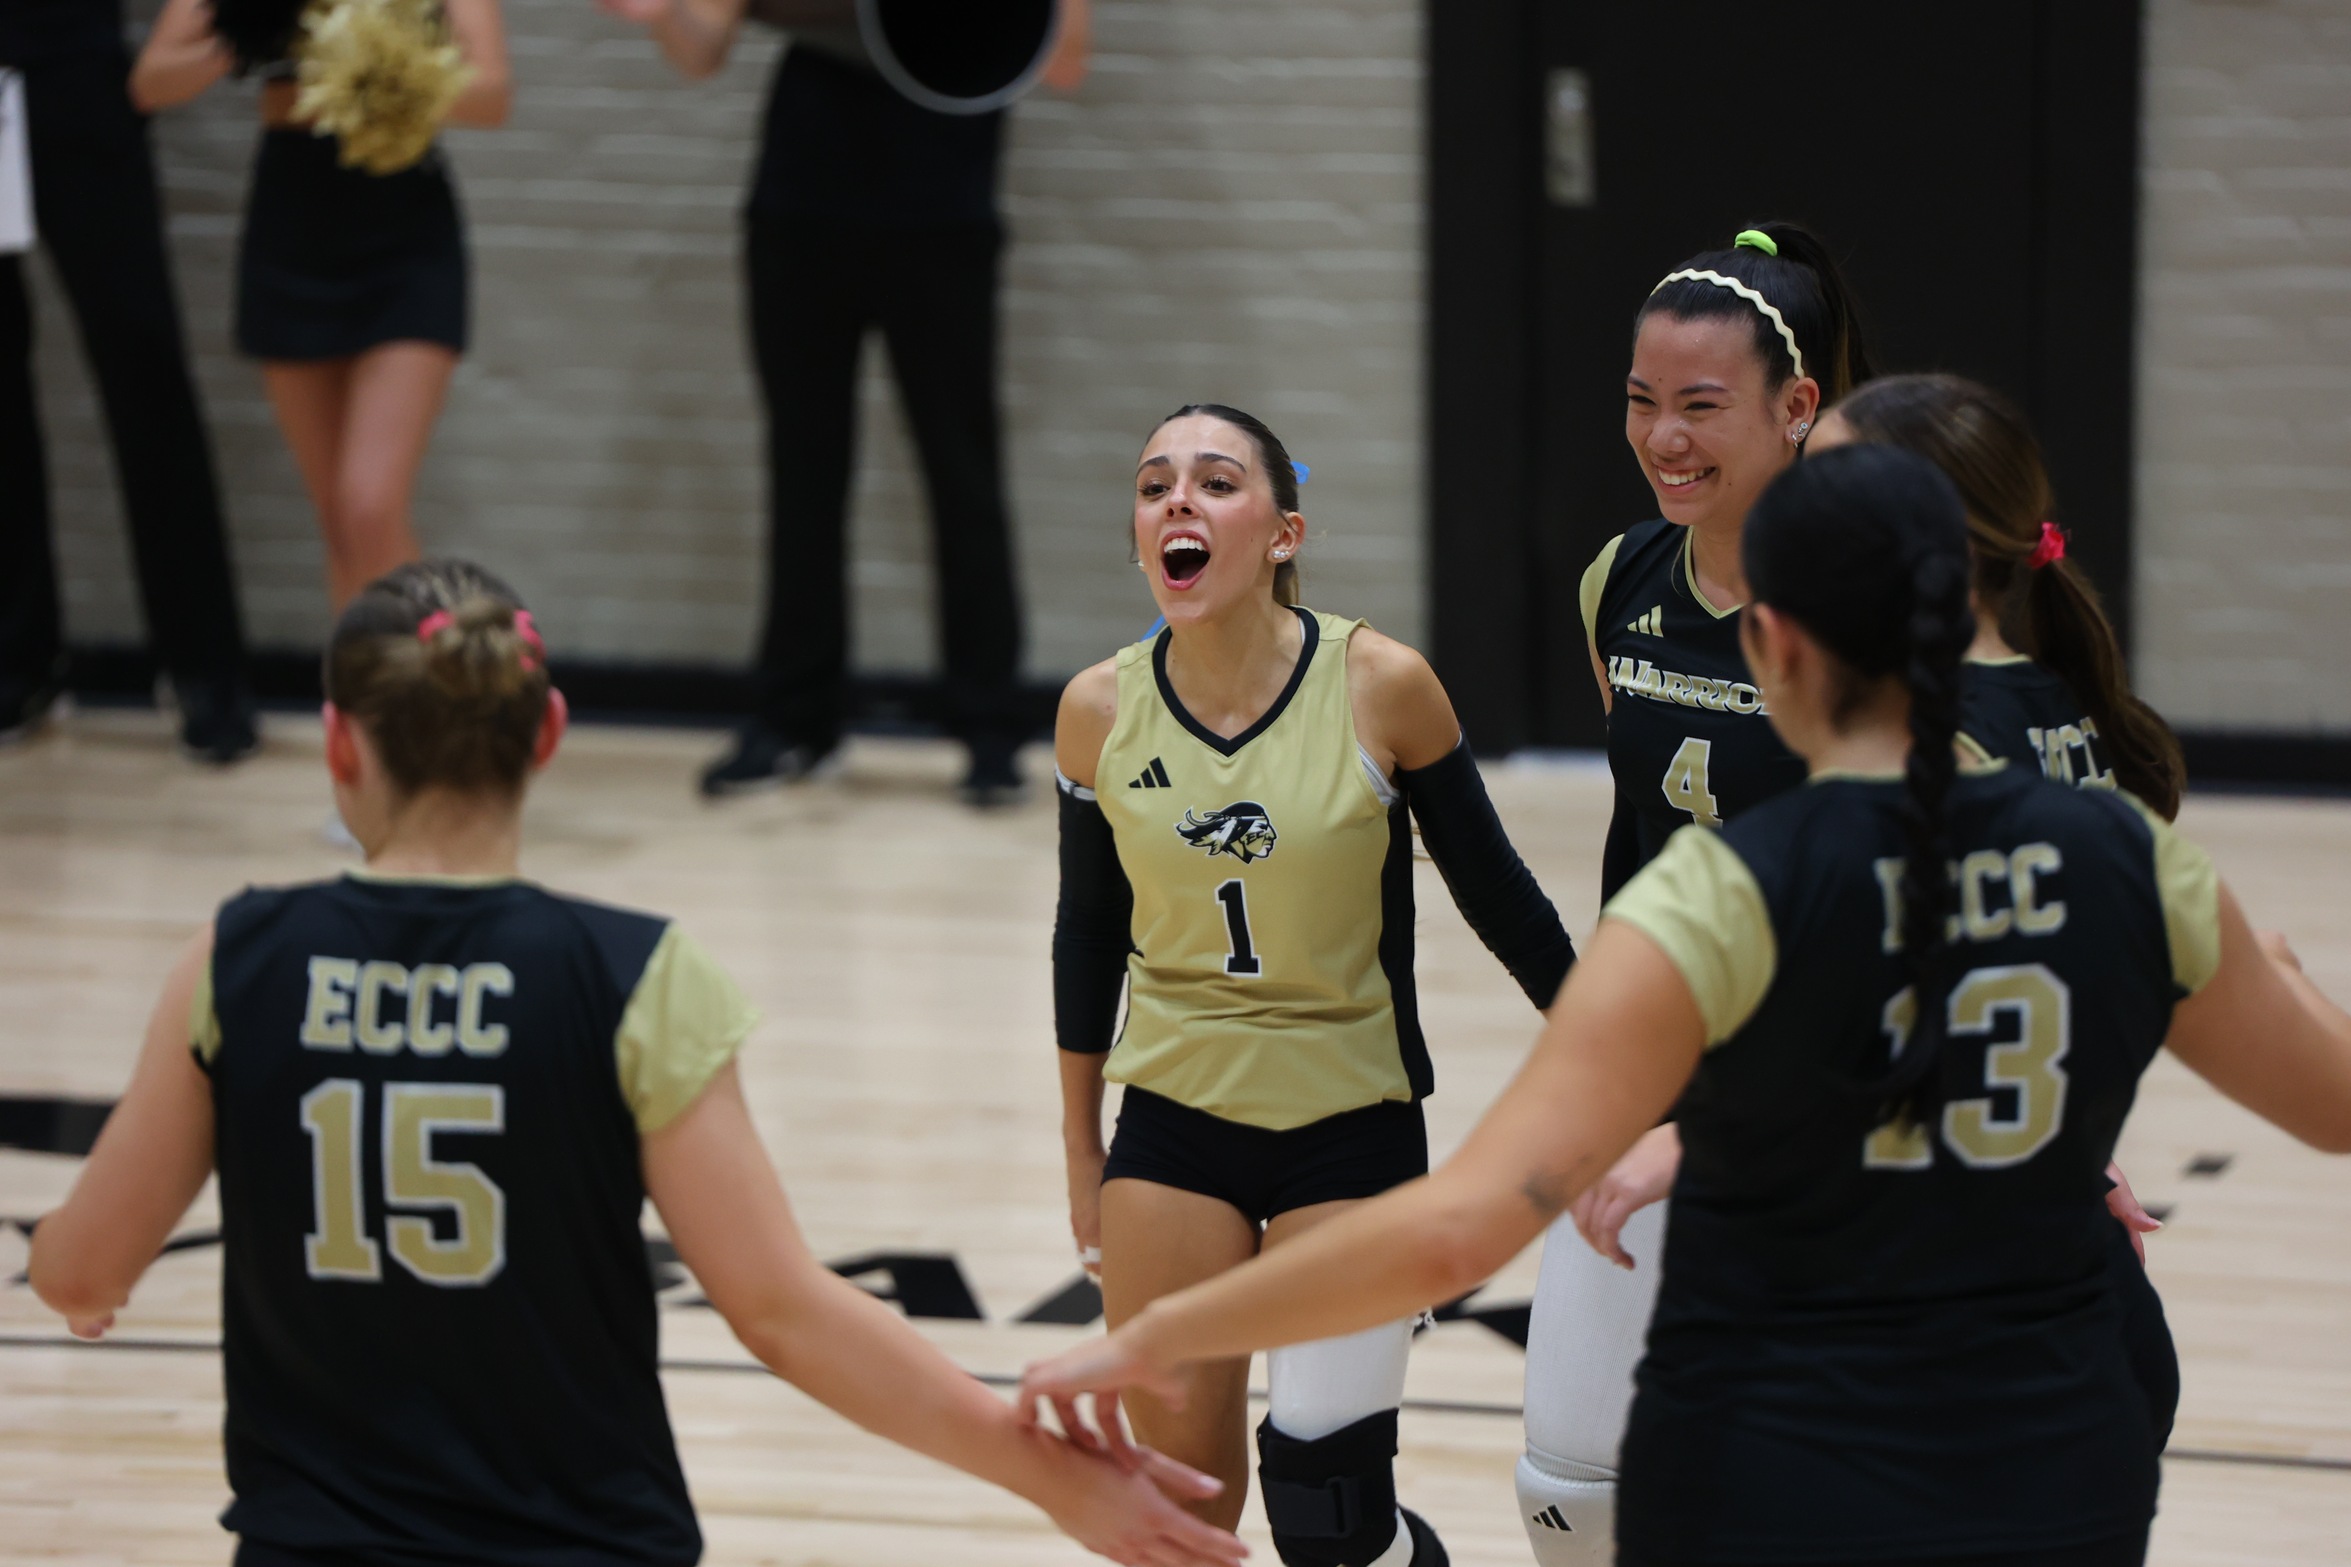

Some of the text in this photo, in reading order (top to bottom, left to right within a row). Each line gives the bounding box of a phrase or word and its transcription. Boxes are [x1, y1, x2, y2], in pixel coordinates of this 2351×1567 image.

[1609, 655, 1775, 715] WARRIO
[1661, 736, 1723, 829] 4
[1214, 878, 1262, 977] 1
[299, 954, 515, 1057] ECCC
[299, 1077, 507, 1287] 15
